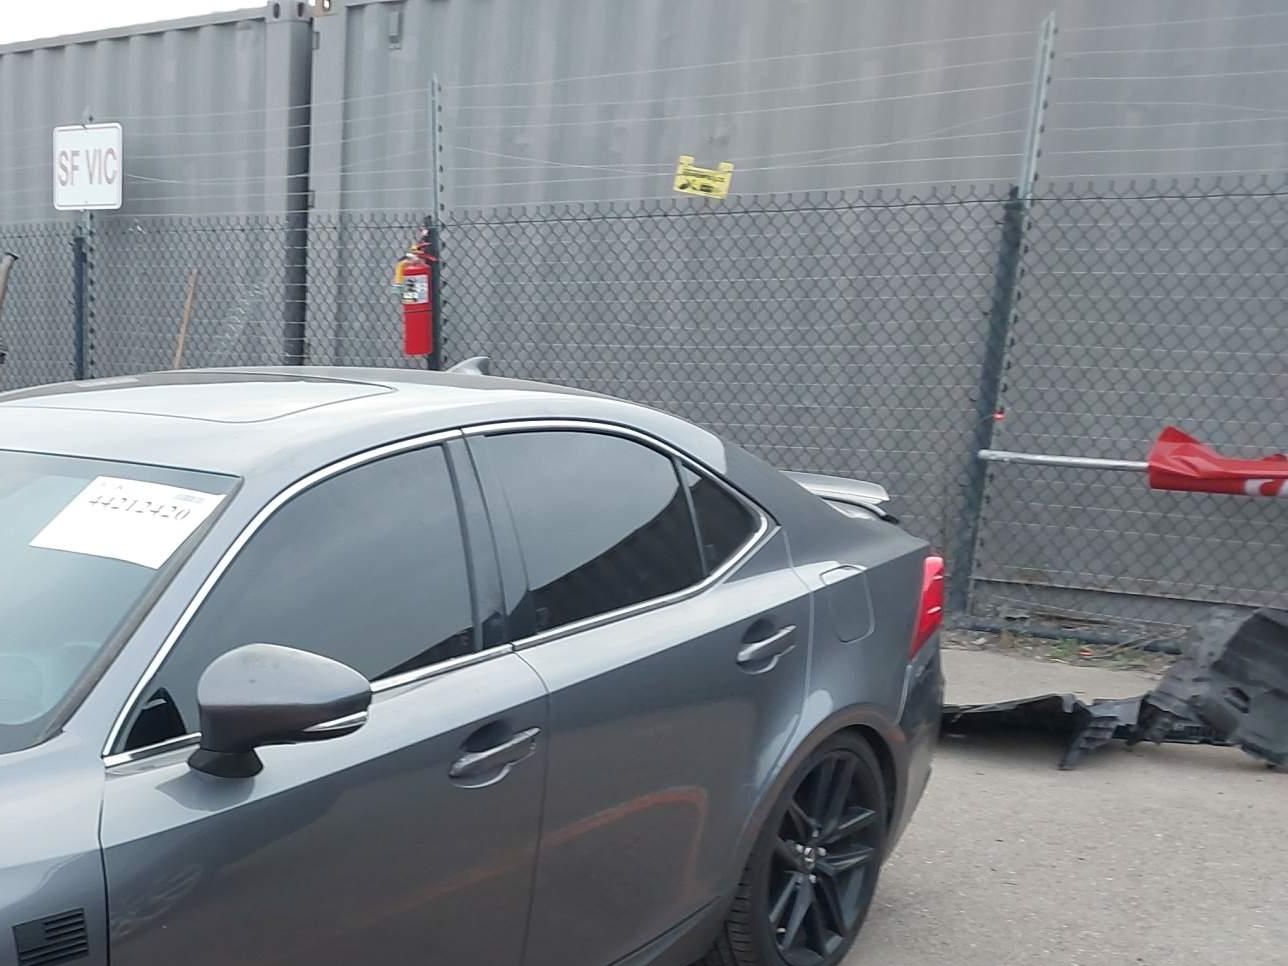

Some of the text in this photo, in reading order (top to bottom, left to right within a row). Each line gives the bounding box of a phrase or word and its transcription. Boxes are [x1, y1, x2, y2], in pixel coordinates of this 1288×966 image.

[57, 147, 117, 187] SF VIC
[89, 495, 191, 520] 44212420
